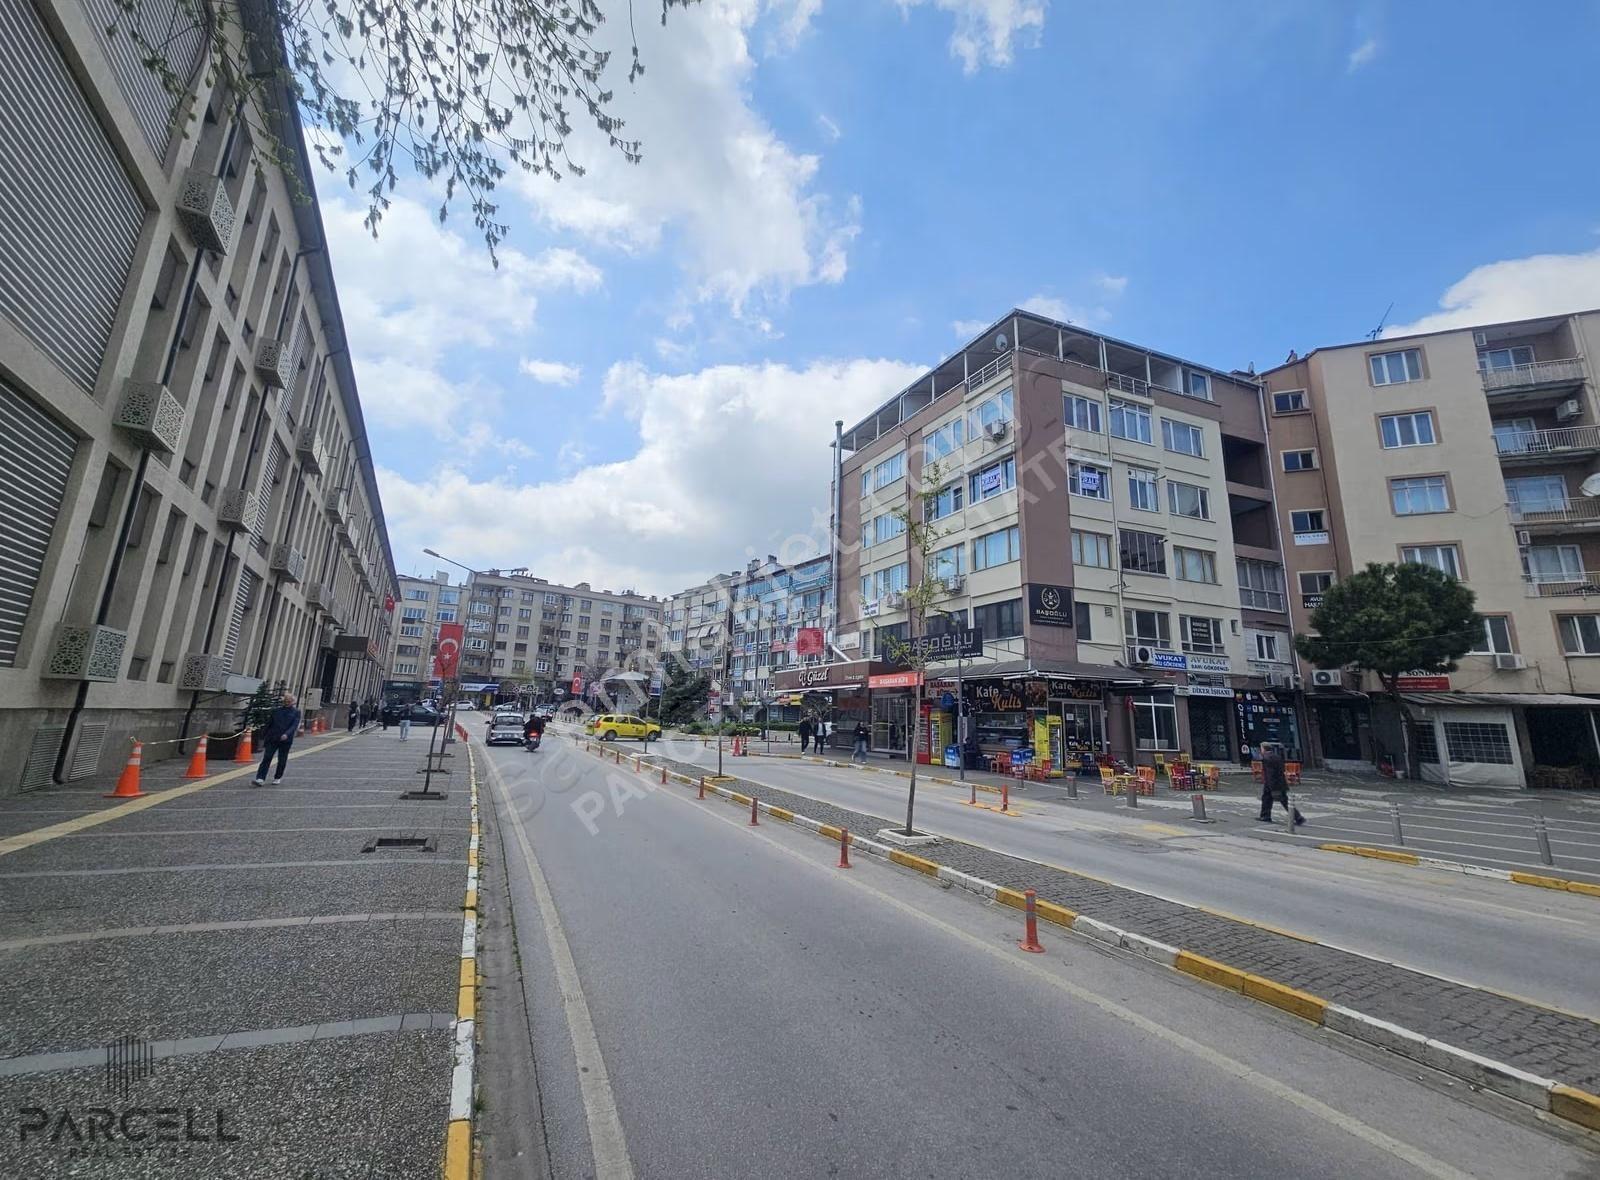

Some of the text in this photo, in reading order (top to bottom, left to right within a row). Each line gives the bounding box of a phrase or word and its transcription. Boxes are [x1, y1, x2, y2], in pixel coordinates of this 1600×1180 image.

[1190, 656, 1227, 666] AVUKAT
[975, 686, 999, 698] Kafe
[1051, 680, 1073, 692] Kafe
[1069, 687, 1097, 698] Kulis
[991, 693, 1023, 711] Kulis
